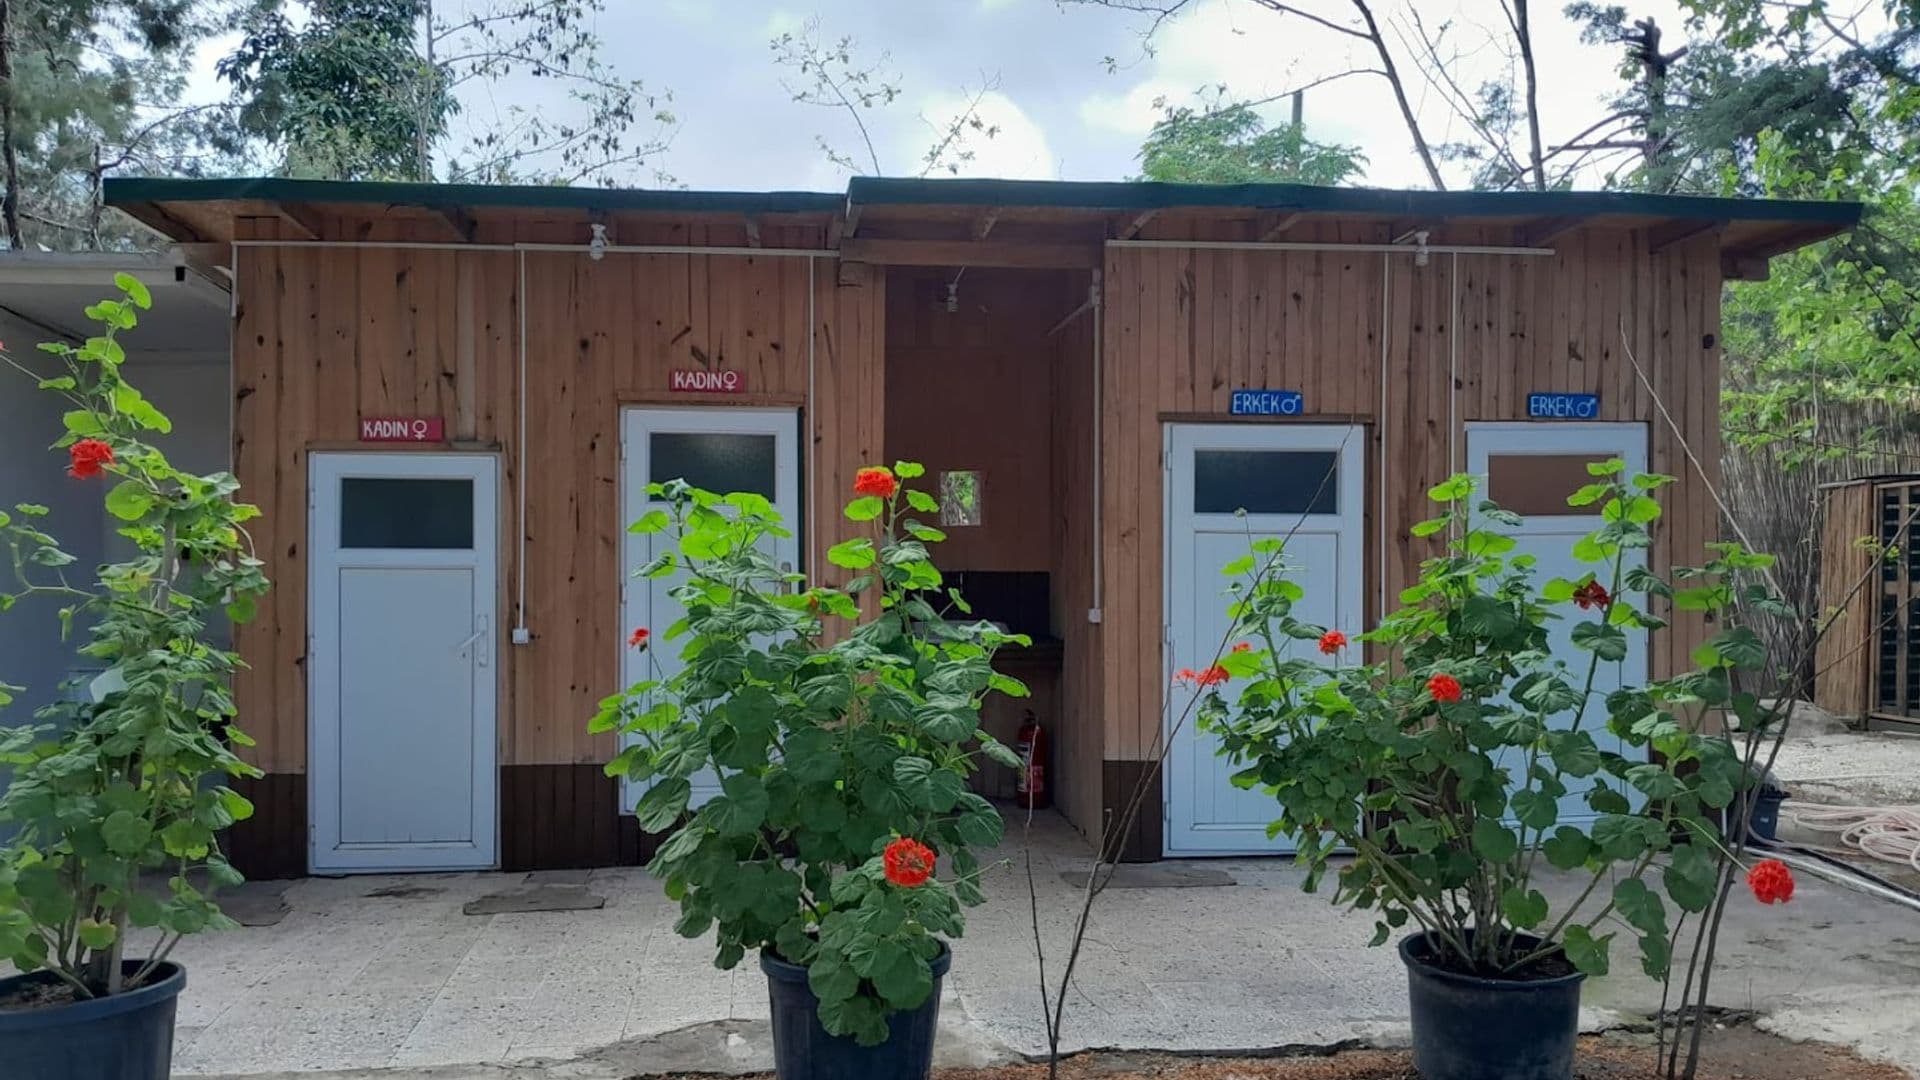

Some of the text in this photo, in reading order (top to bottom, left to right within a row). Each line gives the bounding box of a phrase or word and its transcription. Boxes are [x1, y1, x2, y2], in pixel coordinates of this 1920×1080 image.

[674, 371, 722, 389] KADIN
[1233, 393, 1279, 414] ERKEK
[1530, 396, 1575, 416] ERKEK
[363, 420, 408, 438] KADIN
